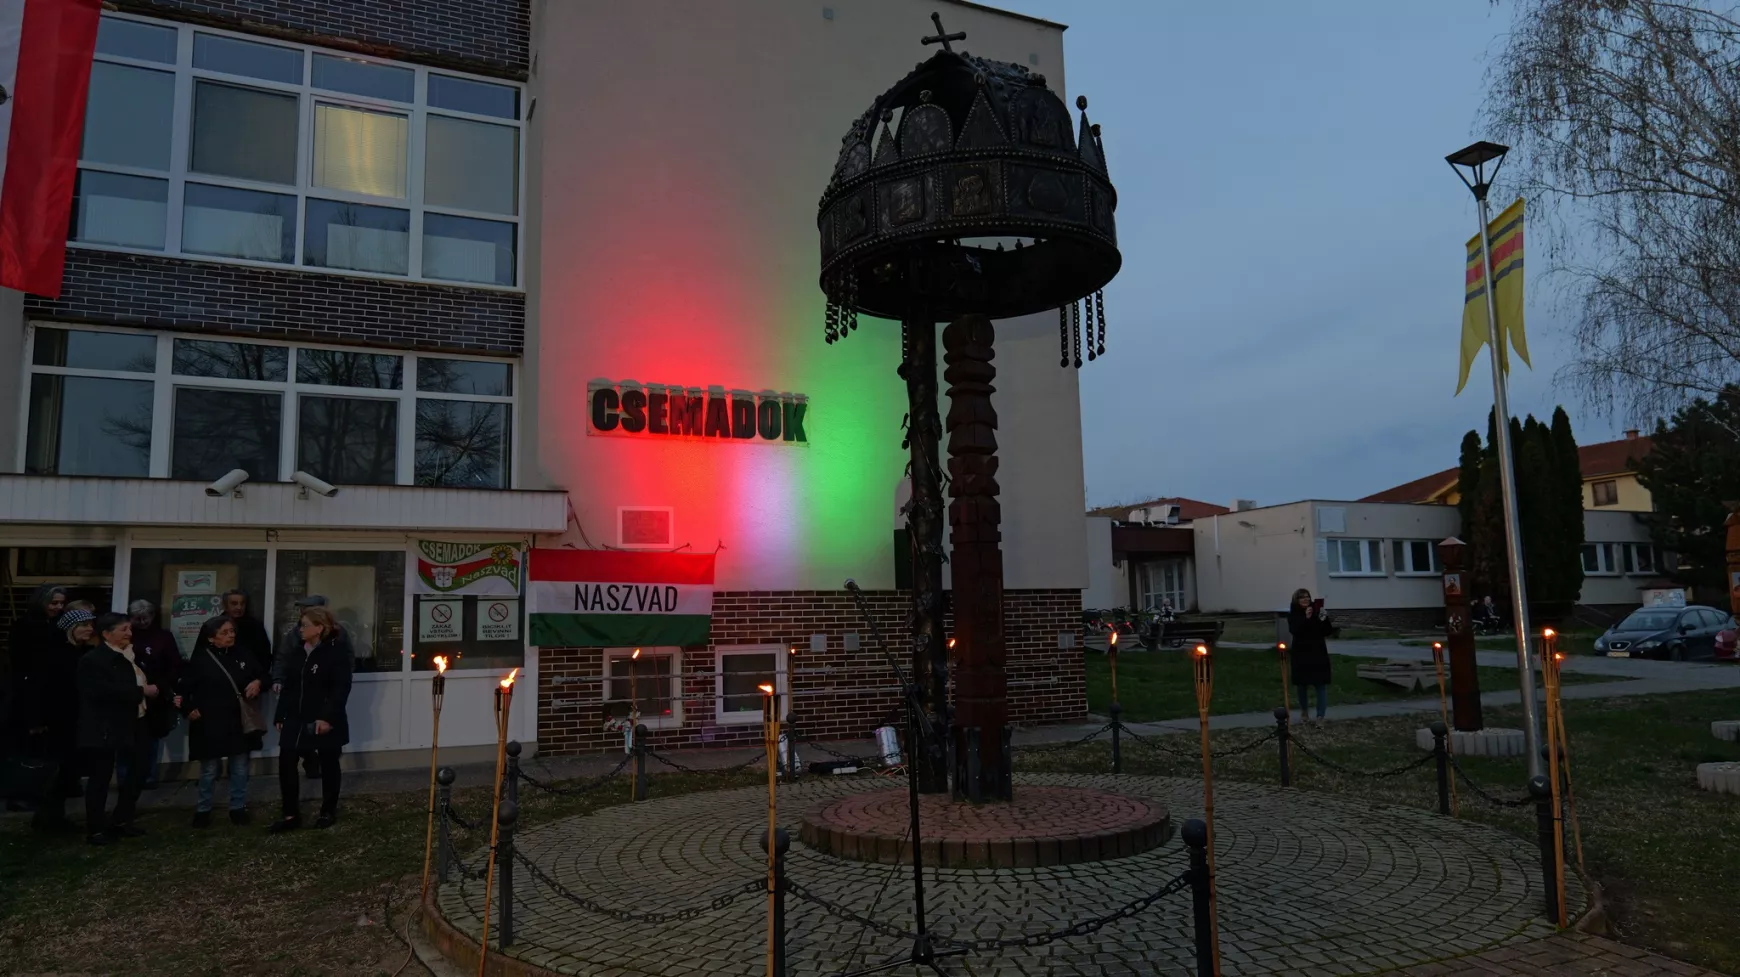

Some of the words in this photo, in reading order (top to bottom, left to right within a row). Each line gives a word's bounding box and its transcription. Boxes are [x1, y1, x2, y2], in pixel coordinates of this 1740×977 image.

[591, 386, 808, 442] CSEMADOK
[421, 541, 481, 562] CSEMADOK
[461, 565, 517, 585] Naszvad
[574, 584, 678, 612] NASZVAD
